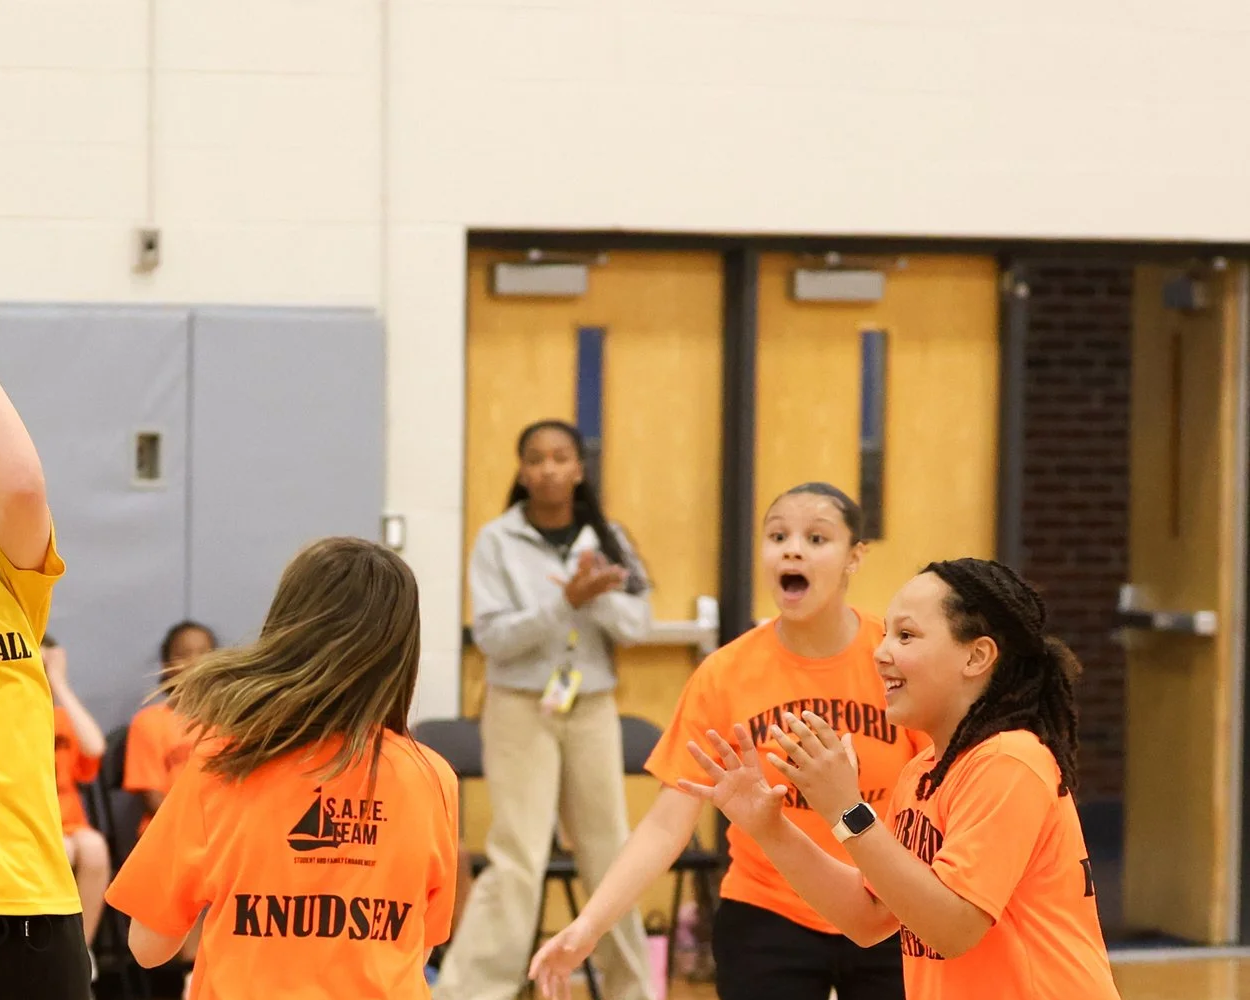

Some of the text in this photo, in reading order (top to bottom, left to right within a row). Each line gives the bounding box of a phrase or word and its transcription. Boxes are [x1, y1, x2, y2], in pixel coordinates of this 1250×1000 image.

[326, 797, 388, 821] S.A.F.E.
[332, 822, 378, 845] TEAM
[233, 894, 412, 941] KNUDSEN
